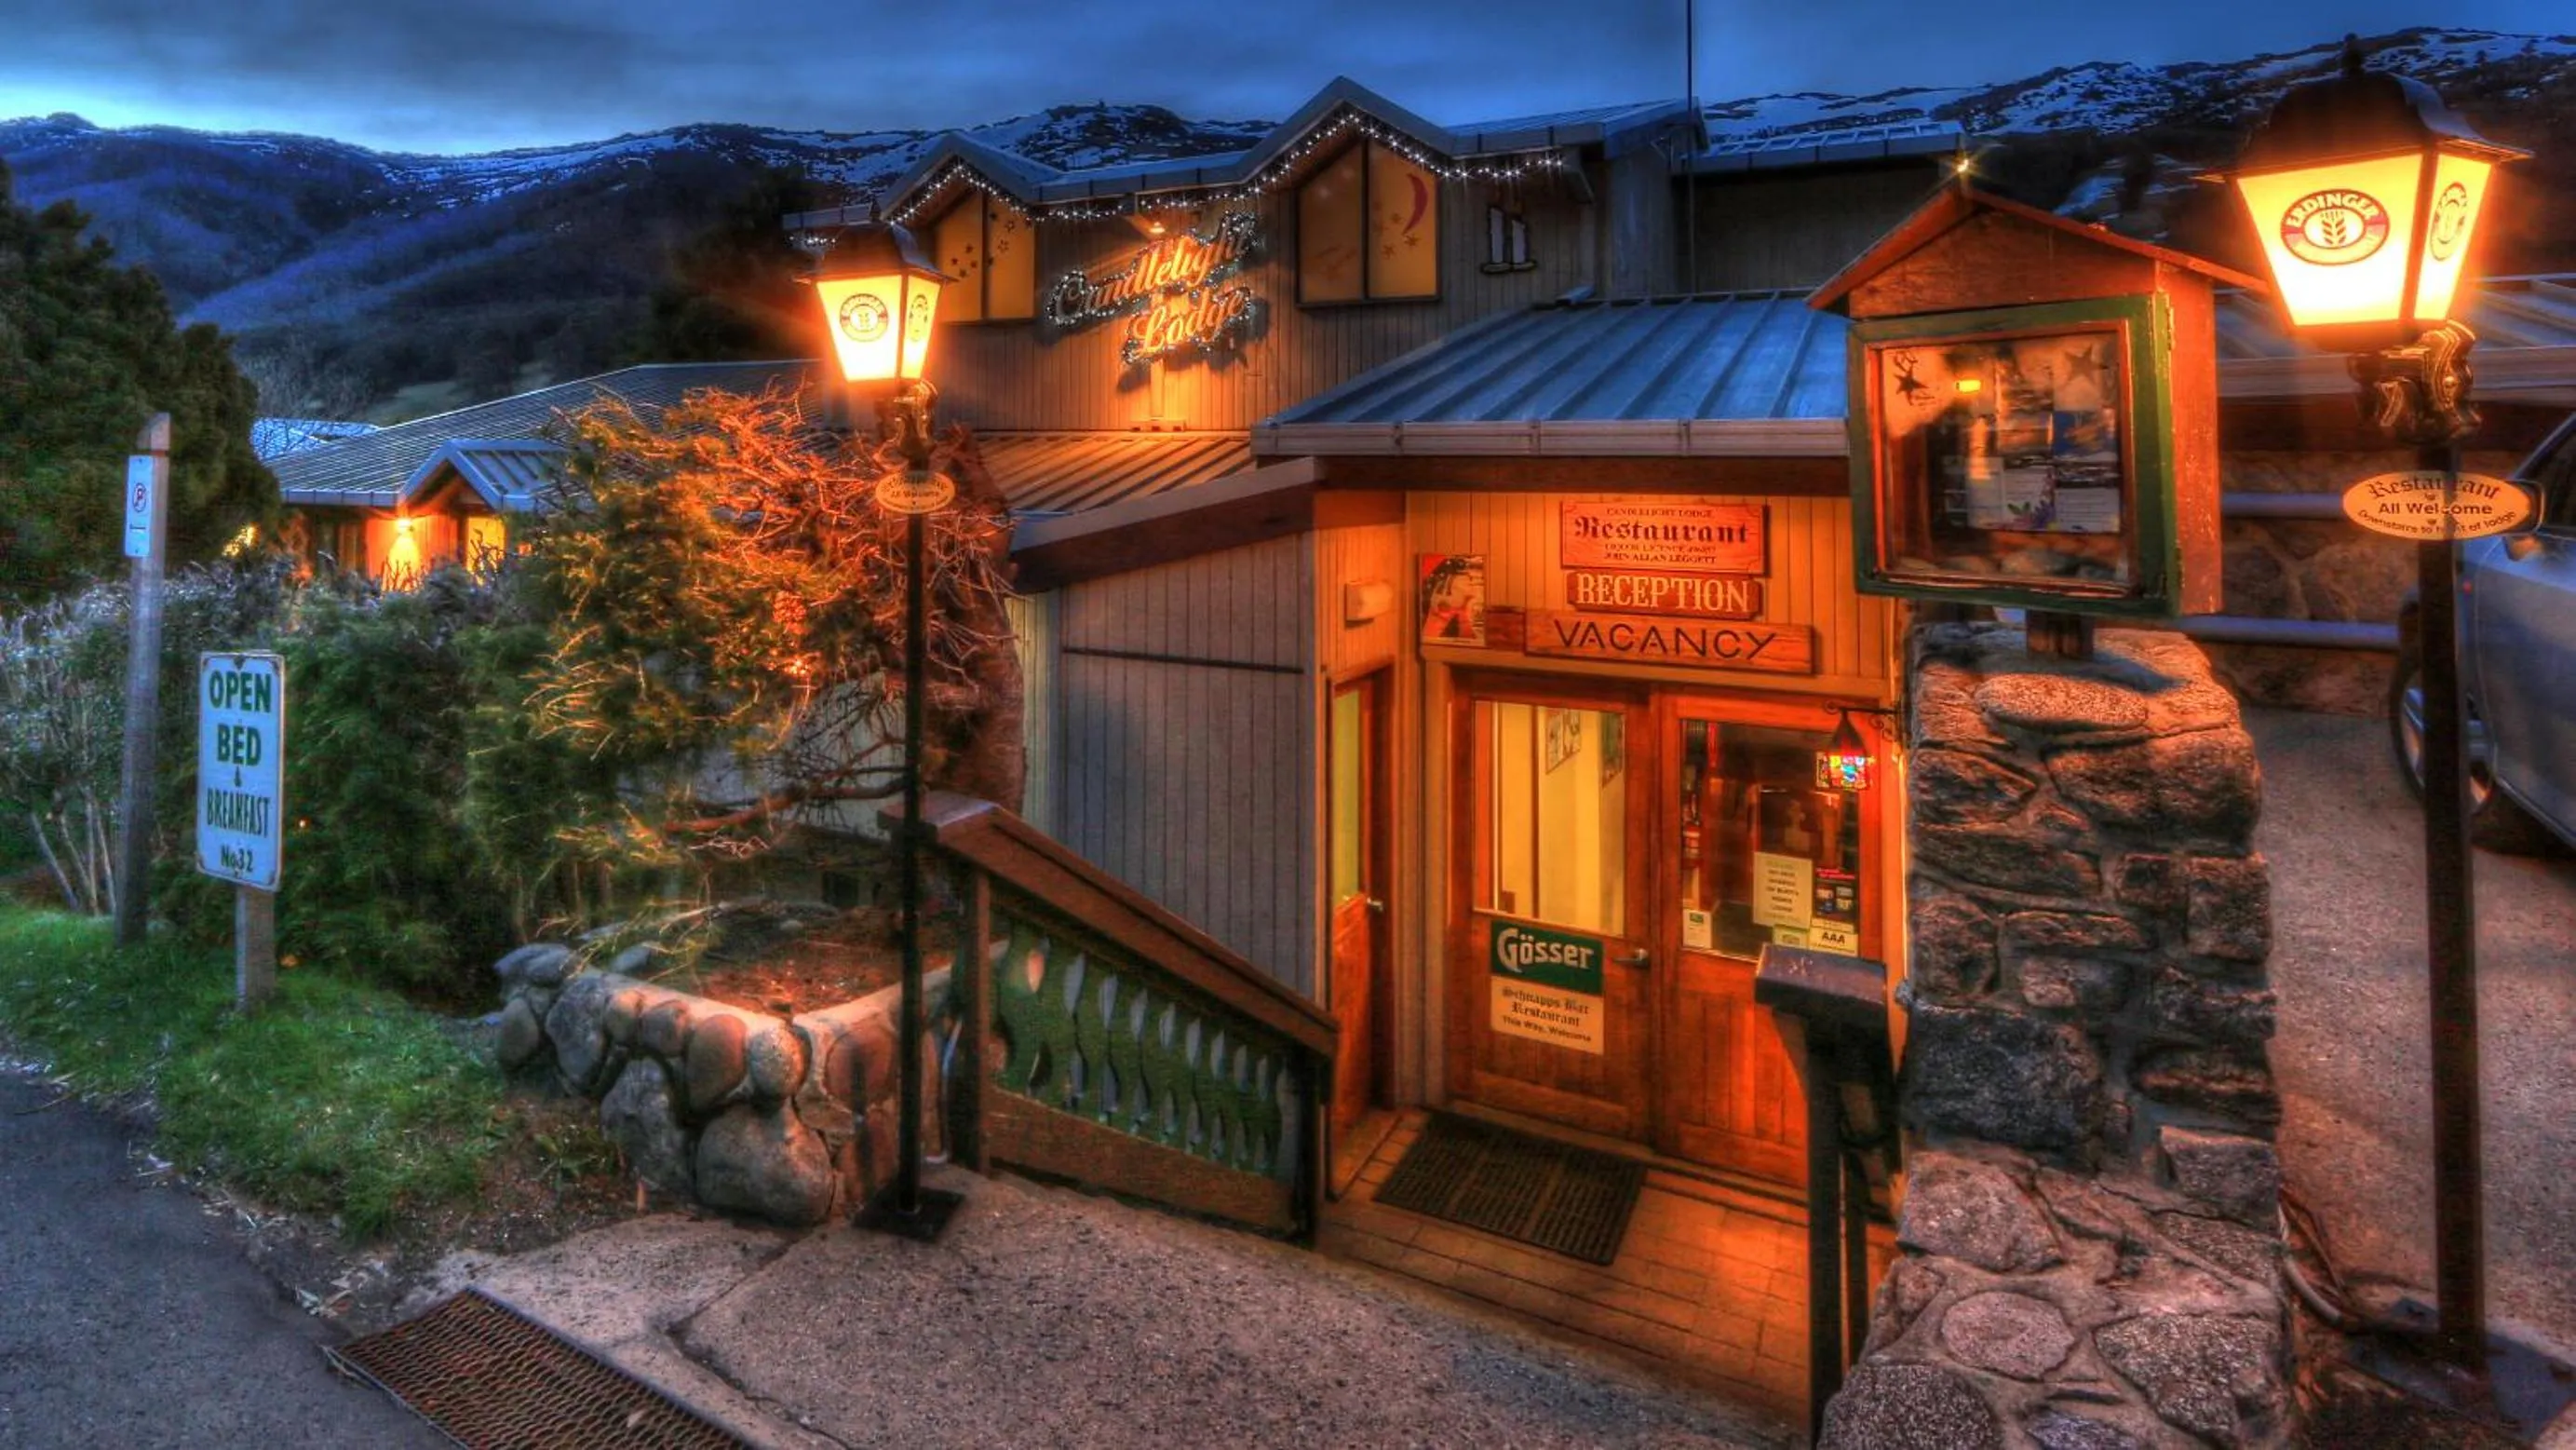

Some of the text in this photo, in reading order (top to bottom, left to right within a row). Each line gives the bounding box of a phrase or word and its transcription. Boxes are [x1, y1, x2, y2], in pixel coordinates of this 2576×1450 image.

[2286, 193, 2380, 228] ERDINGER
[1052, 213, 1257, 320] Candlelight
[1129, 285, 1248, 356] Lodge
[1574, 516, 1748, 543] Restaurant
[1606, 508, 1712, 518] CANDLELIGHT LODGE
[2379, 503, 2493, 515] All Welcome
[1576, 572, 1748, 613] RECEPTION
[1553, 618, 1777, 660] VACANCY
[209, 671, 272, 713] OPEN
[217, 723, 262, 766] BED
[207, 792, 270, 838] BREAKFAST
[1497, 927, 1595, 973] Gösser
[1511, 1001, 1581, 1027] Restaurant
